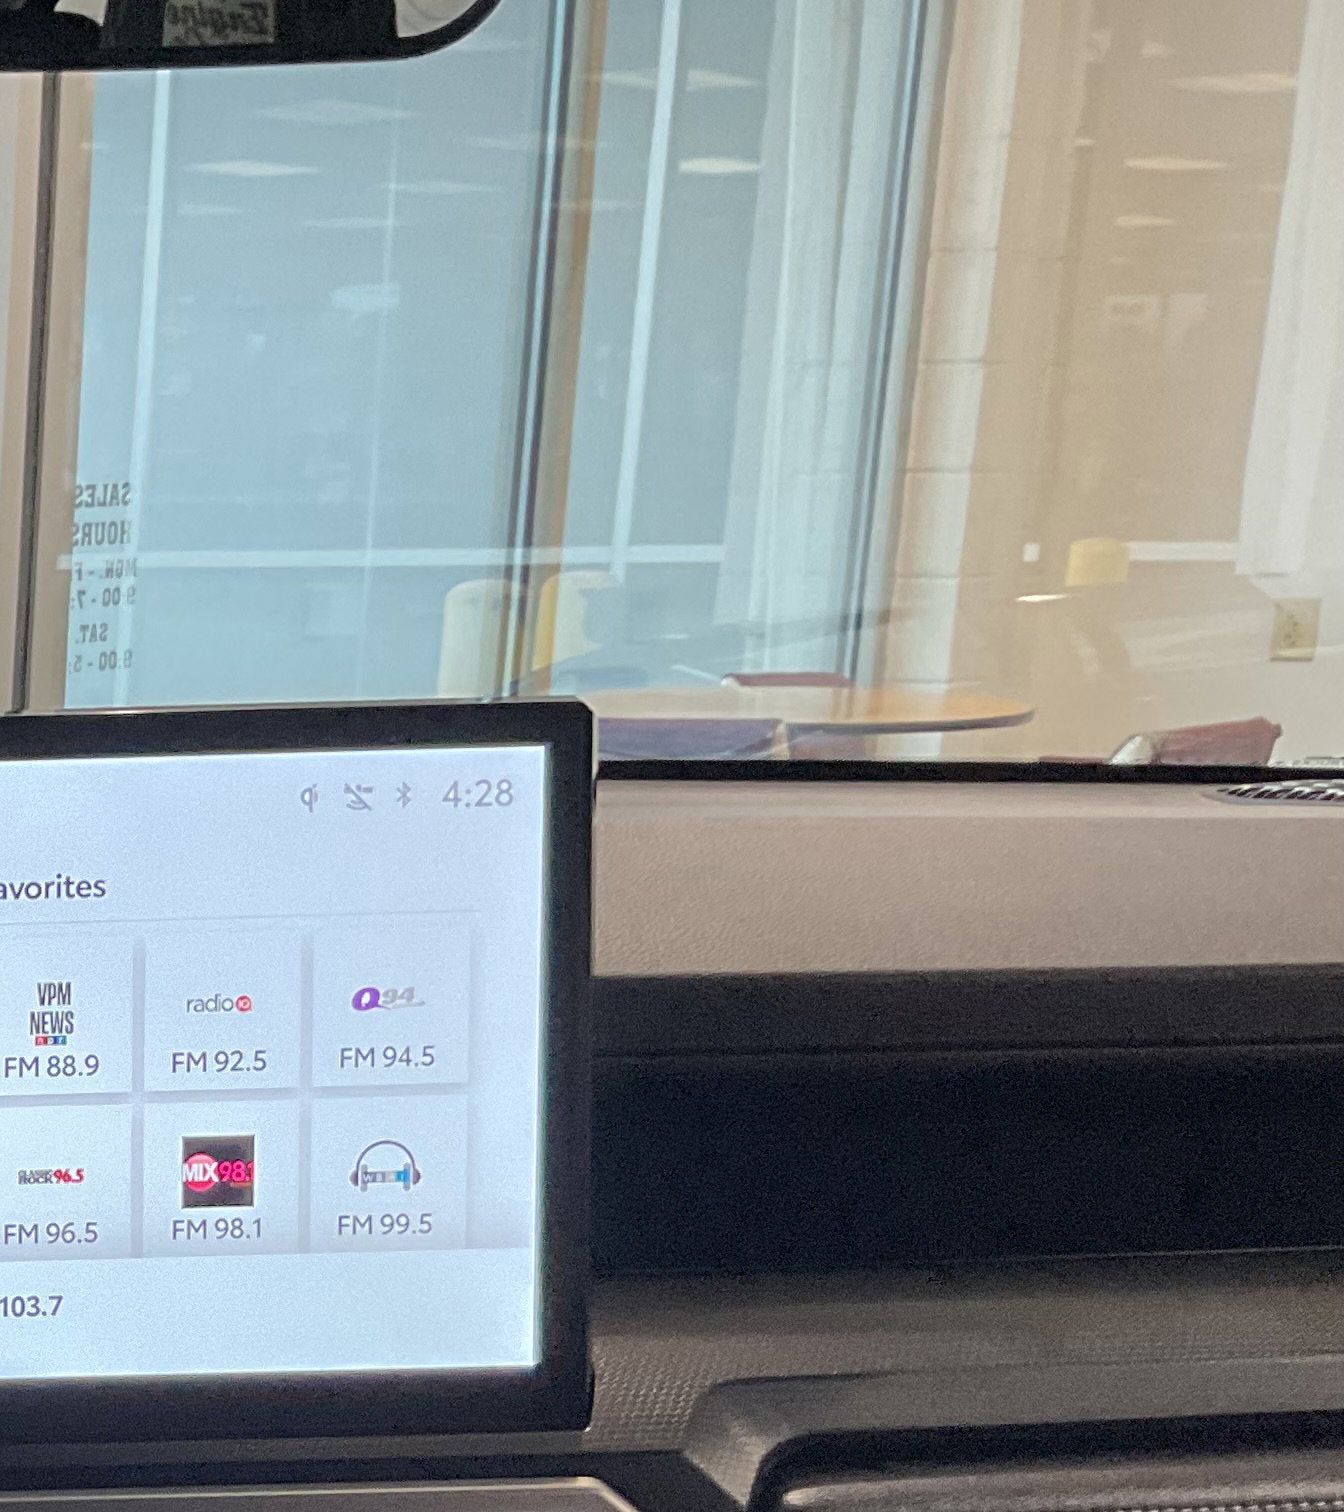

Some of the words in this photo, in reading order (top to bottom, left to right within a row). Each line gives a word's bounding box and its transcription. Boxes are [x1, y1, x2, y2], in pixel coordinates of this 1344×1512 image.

[442, 778, 514, 808] 4:28
[37, 981, 72, 1007] VPM
[30, 1010, 75, 1035] NEWS
[4, 1056, 40, 1078] FM
[47, 1053, 100, 1078] 88.9
[172, 1051, 207, 1073] FM
[214, 1050, 267, 1073] 92.5
[340, 1046, 375, 1069] FM
[383, 1045, 435, 1068] 94.5
[4, 1223, 39, 1244] FM
[46, 1222, 98, 1244] 96.5
[172, 1219, 207, 1240] FM
[215, 1217, 261, 1239] 98.1
[338, 1214, 372, 1235] FM
[380, 1212, 432, 1235] 99.5
[0, 1296, 63, 1319] 103.7
